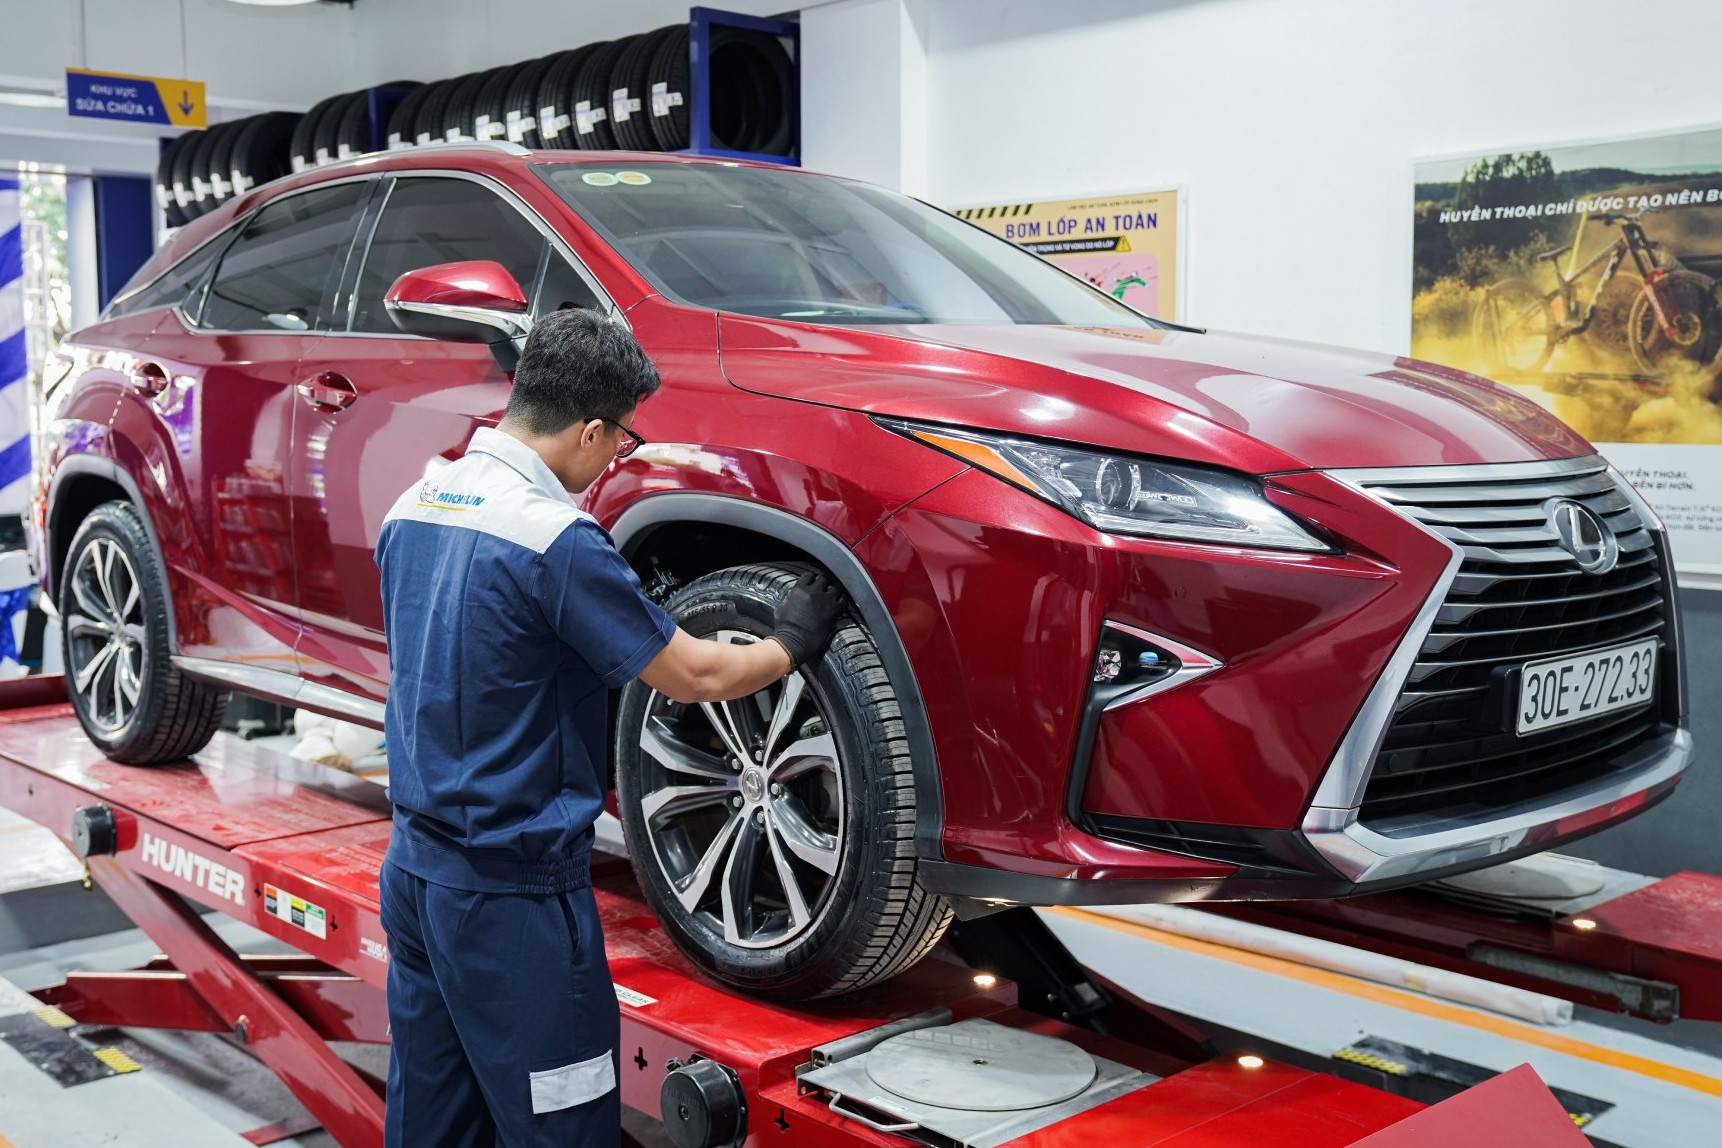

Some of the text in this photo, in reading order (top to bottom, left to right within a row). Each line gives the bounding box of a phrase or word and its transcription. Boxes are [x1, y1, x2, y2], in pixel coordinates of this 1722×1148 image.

[90, 84, 113, 96] KHU
[147, 104, 155, 117] 1
[1439, 204, 1492, 223] HUYỀN
[1494, 204, 1544, 219] THOẠI
[1576, 195, 1624, 213] ĐƯỢC
[1627, 194, 1663, 209] TẠO
[1665, 188, 1704, 206] NÊN
[1006, 210, 1158, 239] BƠM LỐP AN TOÀN
[142, 832, 245, 906] HUNTER
